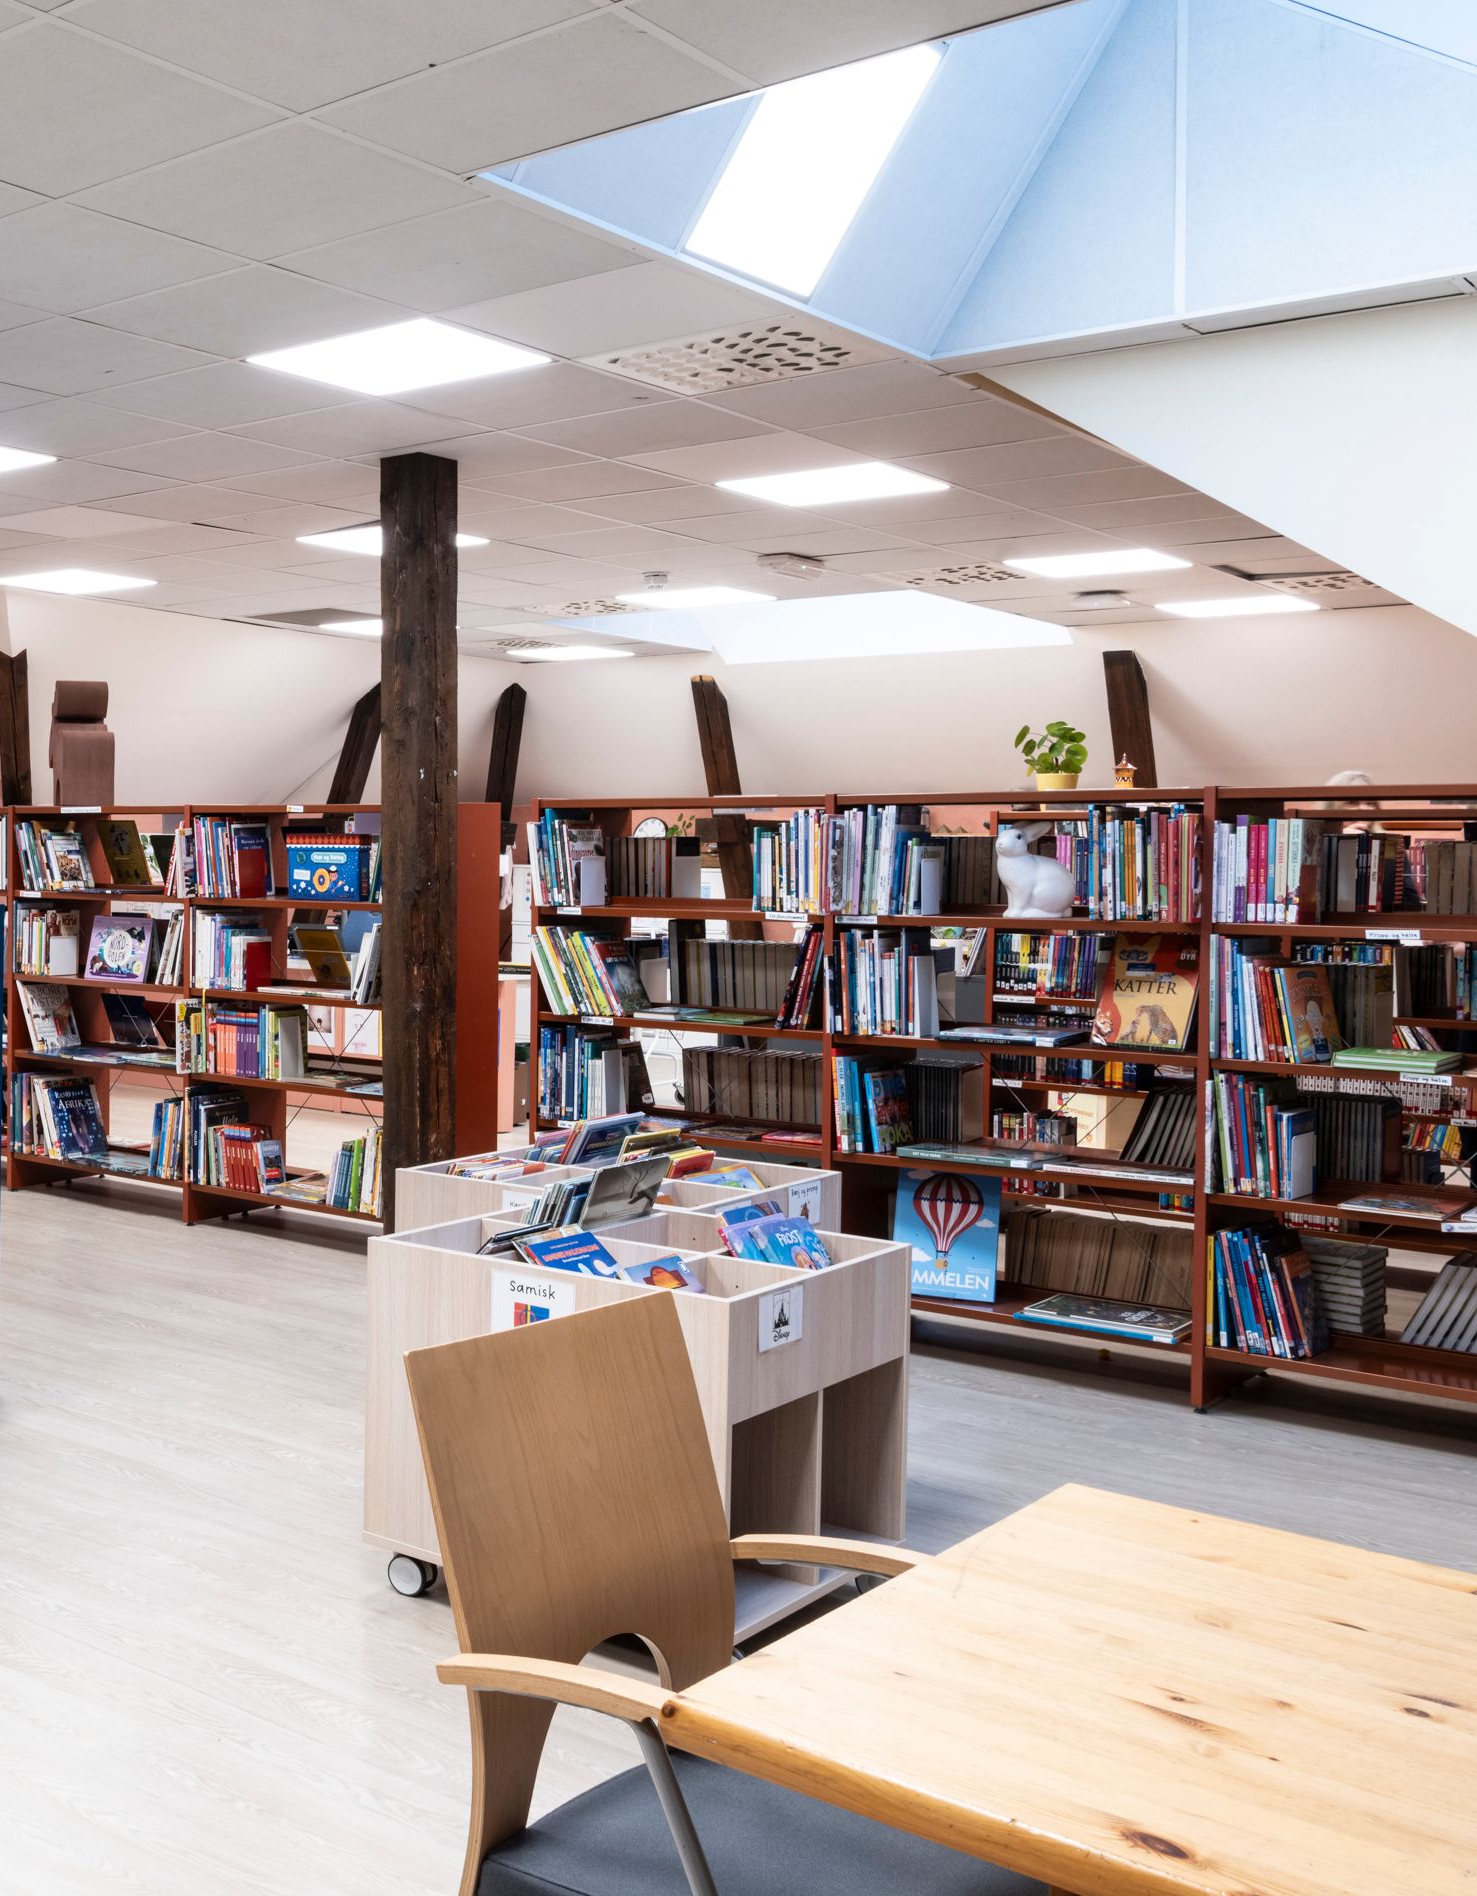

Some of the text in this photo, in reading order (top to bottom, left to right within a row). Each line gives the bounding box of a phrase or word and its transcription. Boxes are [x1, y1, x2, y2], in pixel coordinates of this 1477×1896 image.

[1180, 952, 1196, 961] DYR
[1113, 977, 1178, 995] KATTER
[775, 1228, 803, 1248] FROST
[509, 1279, 556, 1300] Samisk
[913, 1270, 990, 1291] MMELEN
[773, 1328, 790, 1344] Disney
